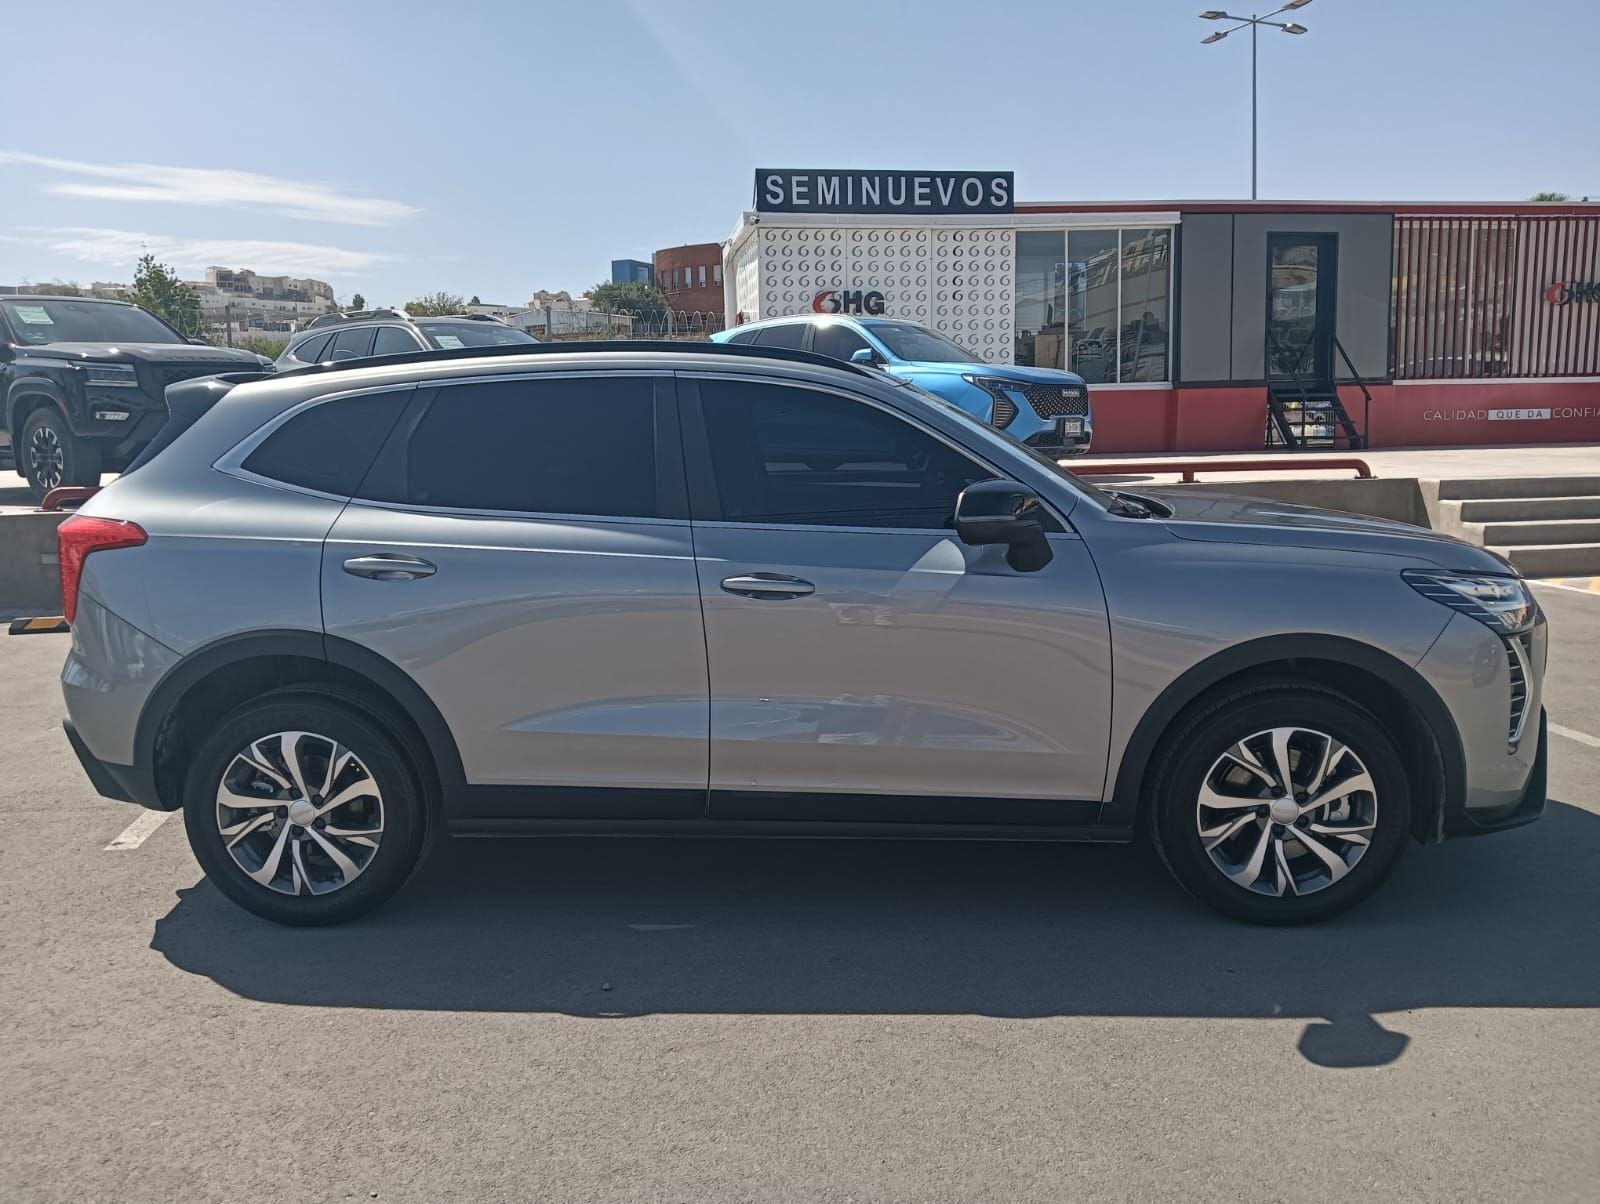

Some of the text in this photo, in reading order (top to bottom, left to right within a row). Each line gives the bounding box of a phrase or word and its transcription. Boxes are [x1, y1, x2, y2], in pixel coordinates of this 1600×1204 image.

[765, 175, 1009, 207] SEMINUEVOS
[1423, 409, 1487, 421] CALIDAD
[1496, 410, 1521, 419] QUE
[1527, 410, 1544, 419] DA
